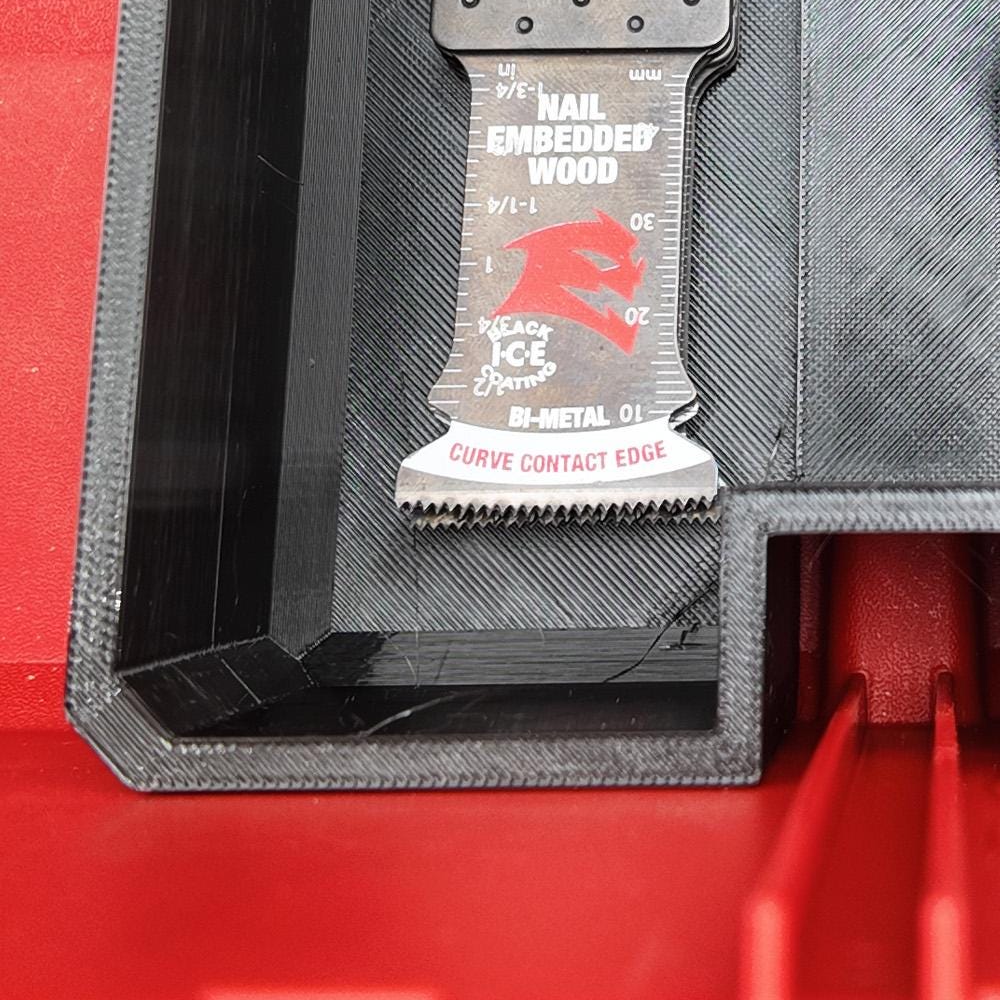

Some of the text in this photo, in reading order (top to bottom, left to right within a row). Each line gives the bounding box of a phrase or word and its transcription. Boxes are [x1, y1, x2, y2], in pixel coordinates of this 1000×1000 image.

[498, 63, 516, 81] in
[629, 69, 662, 81] mm
[537, 93, 607, 121] NAIL
[486, 124, 653, 154] EMBEDDED
[527, 157, 619, 185] WOOD
[487, 196, 538, 215] 1-1/4
[630, 213, 655, 231] 30
[625, 306, 650, 325] 20
[486, 319, 554, 343] BLACK
[480, 361, 558, 391] COATING
[508, 405, 611, 429] BI-METAL
[619, 403, 643, 423] 10
[449, 440, 668, 473] CURVE CONTACT EDGE
